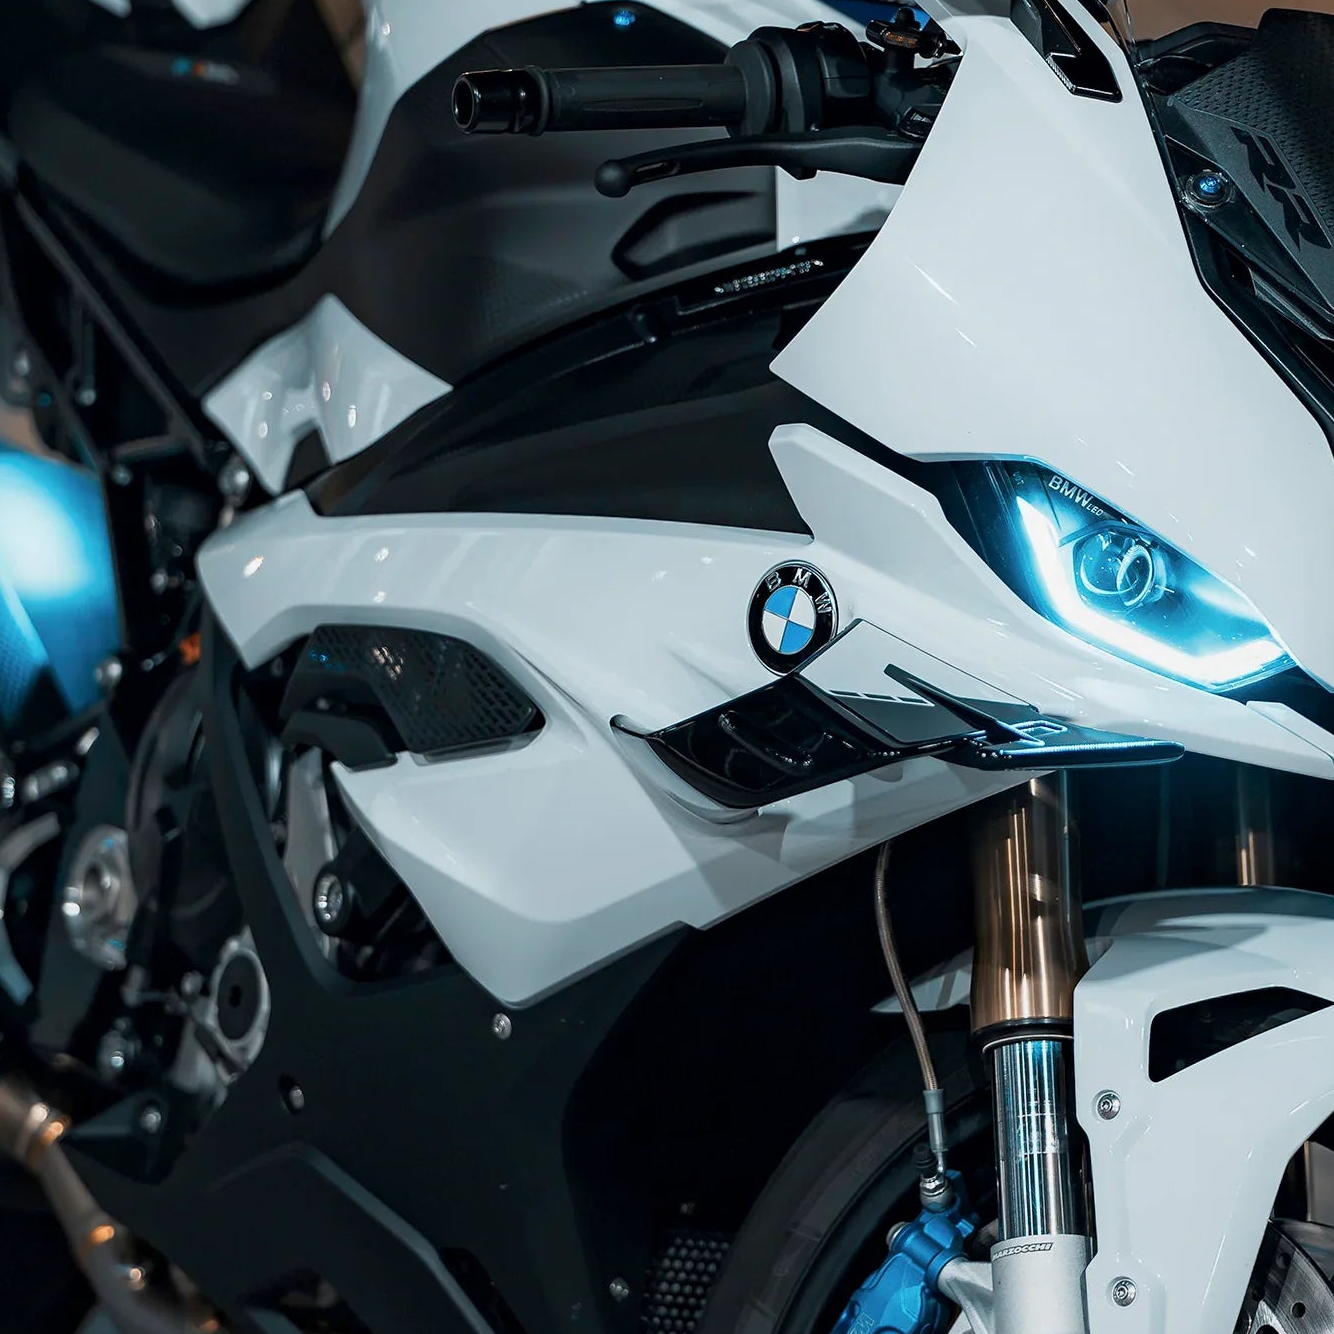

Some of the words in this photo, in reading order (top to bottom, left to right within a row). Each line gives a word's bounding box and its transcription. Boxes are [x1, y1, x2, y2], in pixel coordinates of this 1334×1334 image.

[1048, 474, 1093, 507] BMW
[1086, 503, 1104, 516] LED
[765, 568, 832, 614] BMW
